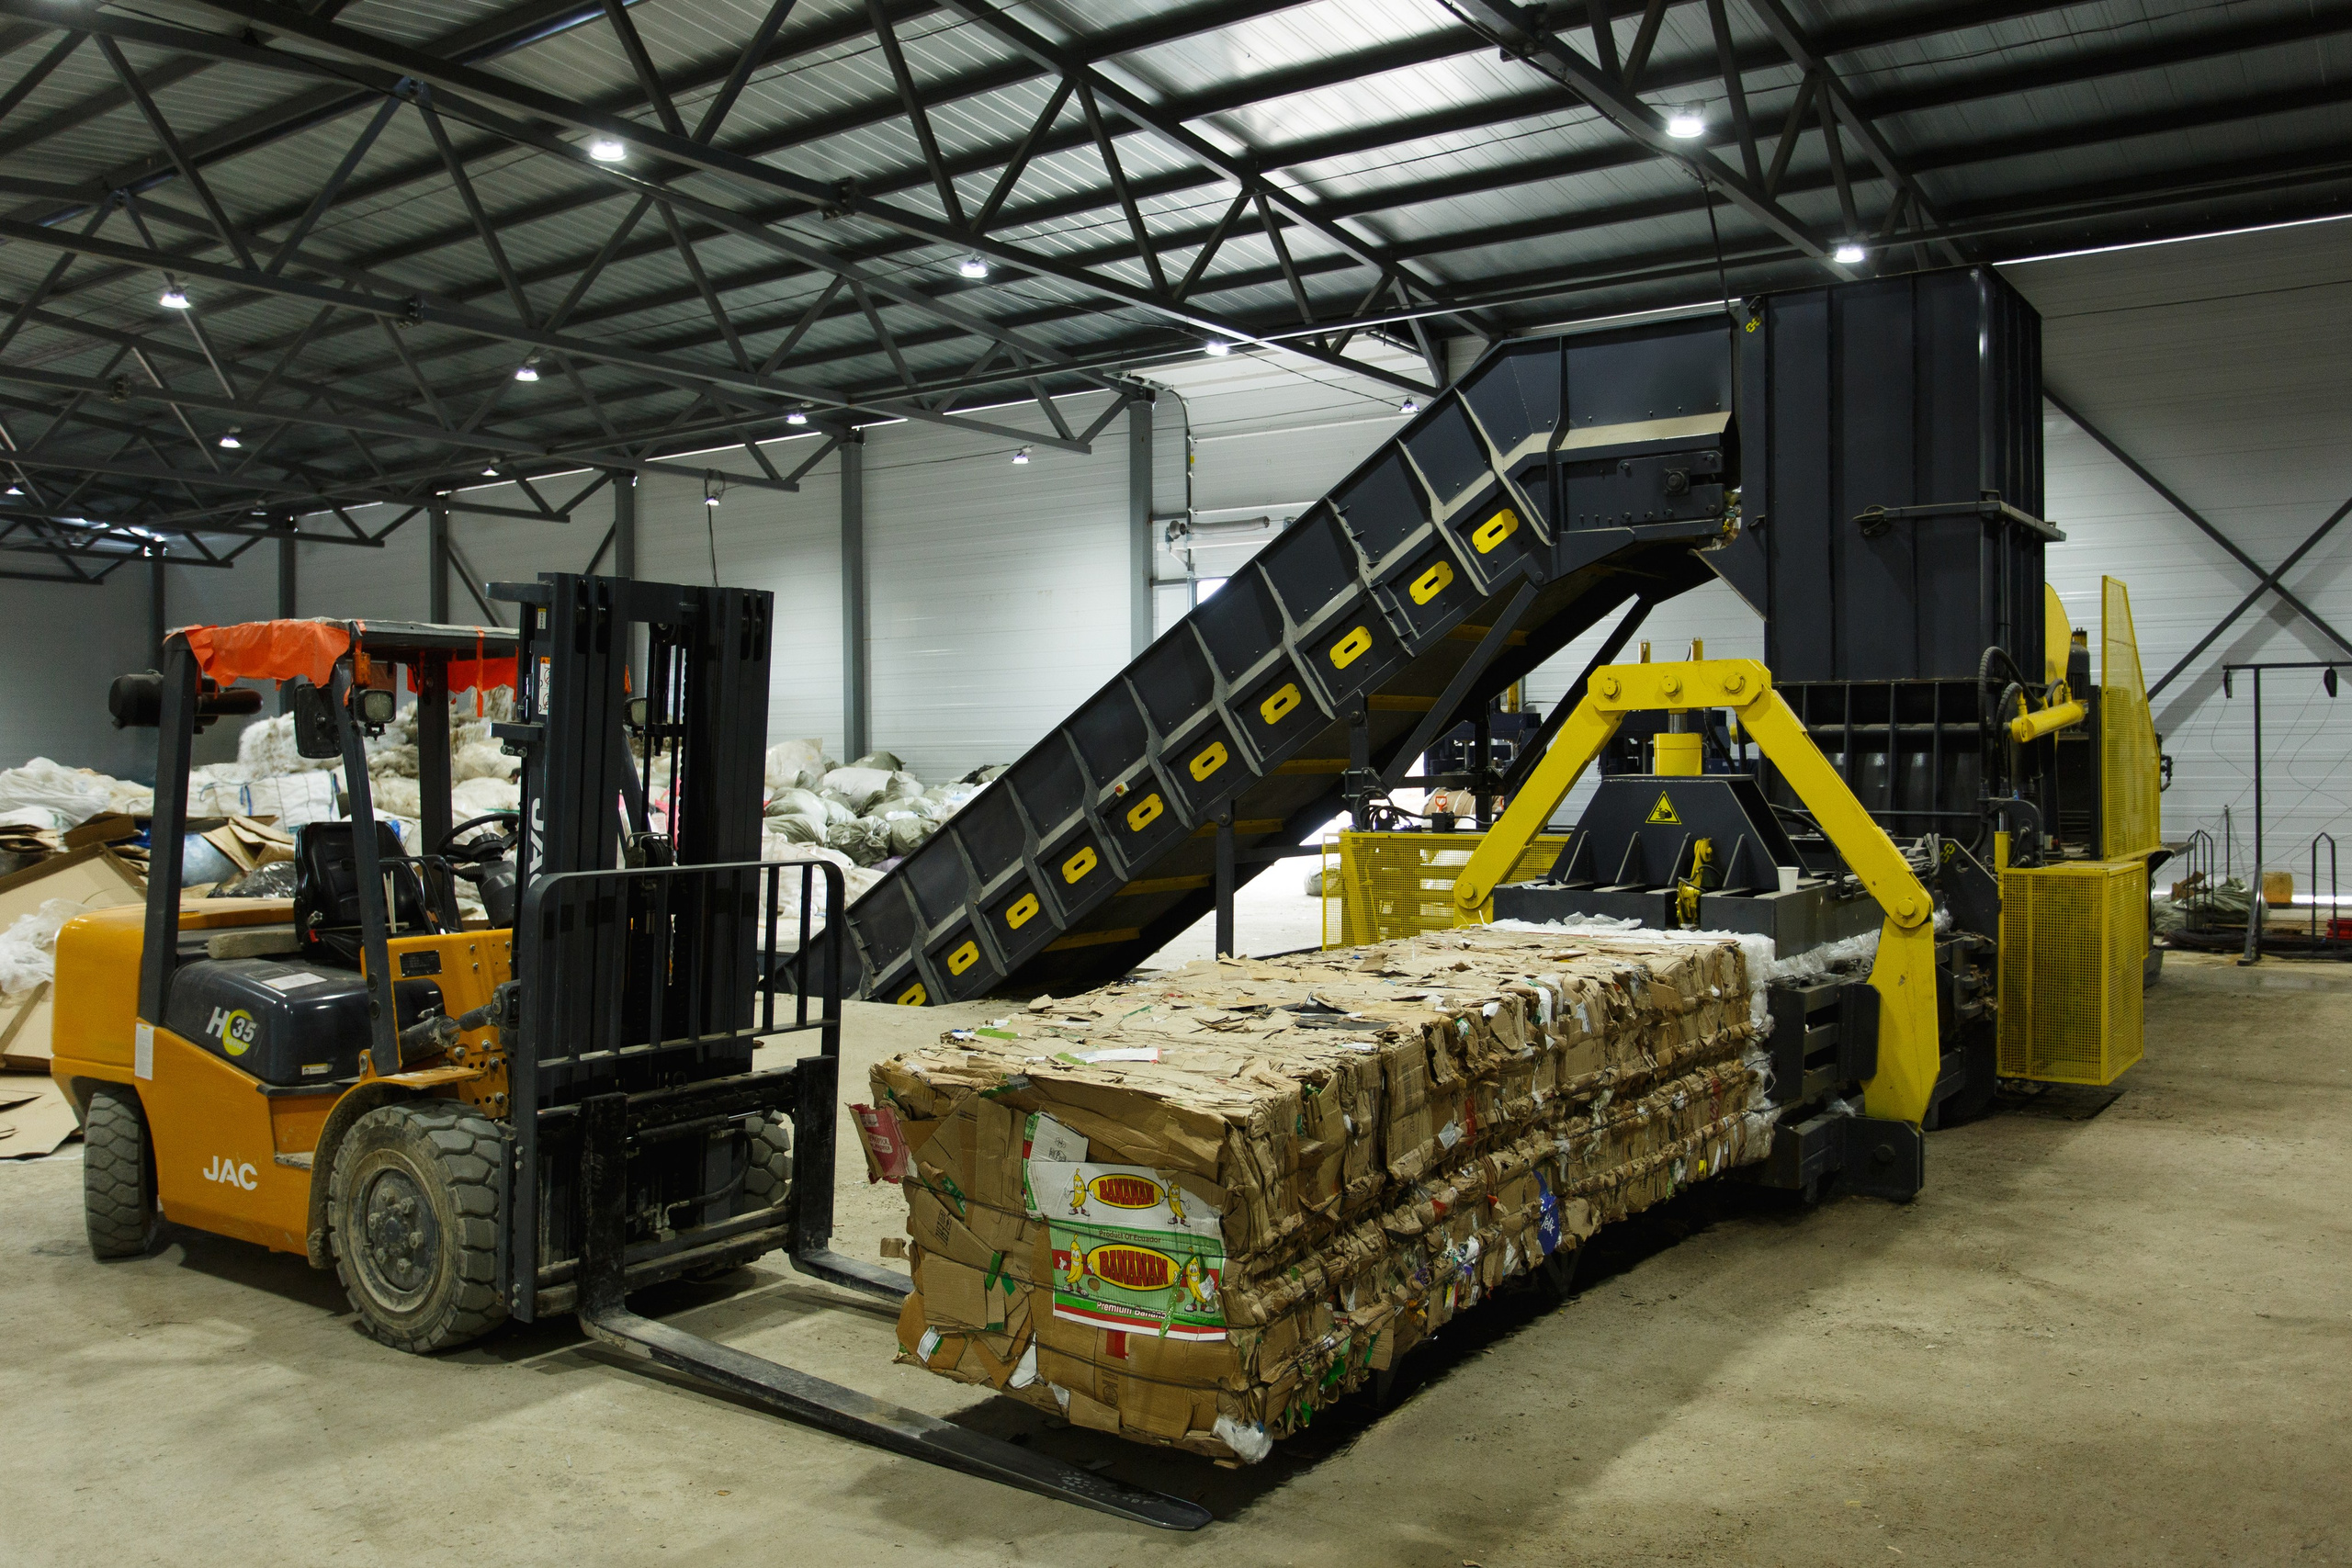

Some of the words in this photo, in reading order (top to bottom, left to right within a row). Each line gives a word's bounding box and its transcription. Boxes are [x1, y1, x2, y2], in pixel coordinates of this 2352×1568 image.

[530, 797, 544, 889] JA
[205, 1006, 231, 1039] H
[232, 1017, 257, 1043] 35
[202, 1155, 258, 1190] JAC
[1098, 1178, 1155, 1206] BANANAN
[1098, 1230, 1124, 1240] Product
[1134, 1234, 1161, 1244] Ecuador
[1098, 1249, 1169, 1287] BANANAN
[1096, 1301, 1133, 1315] Premium
